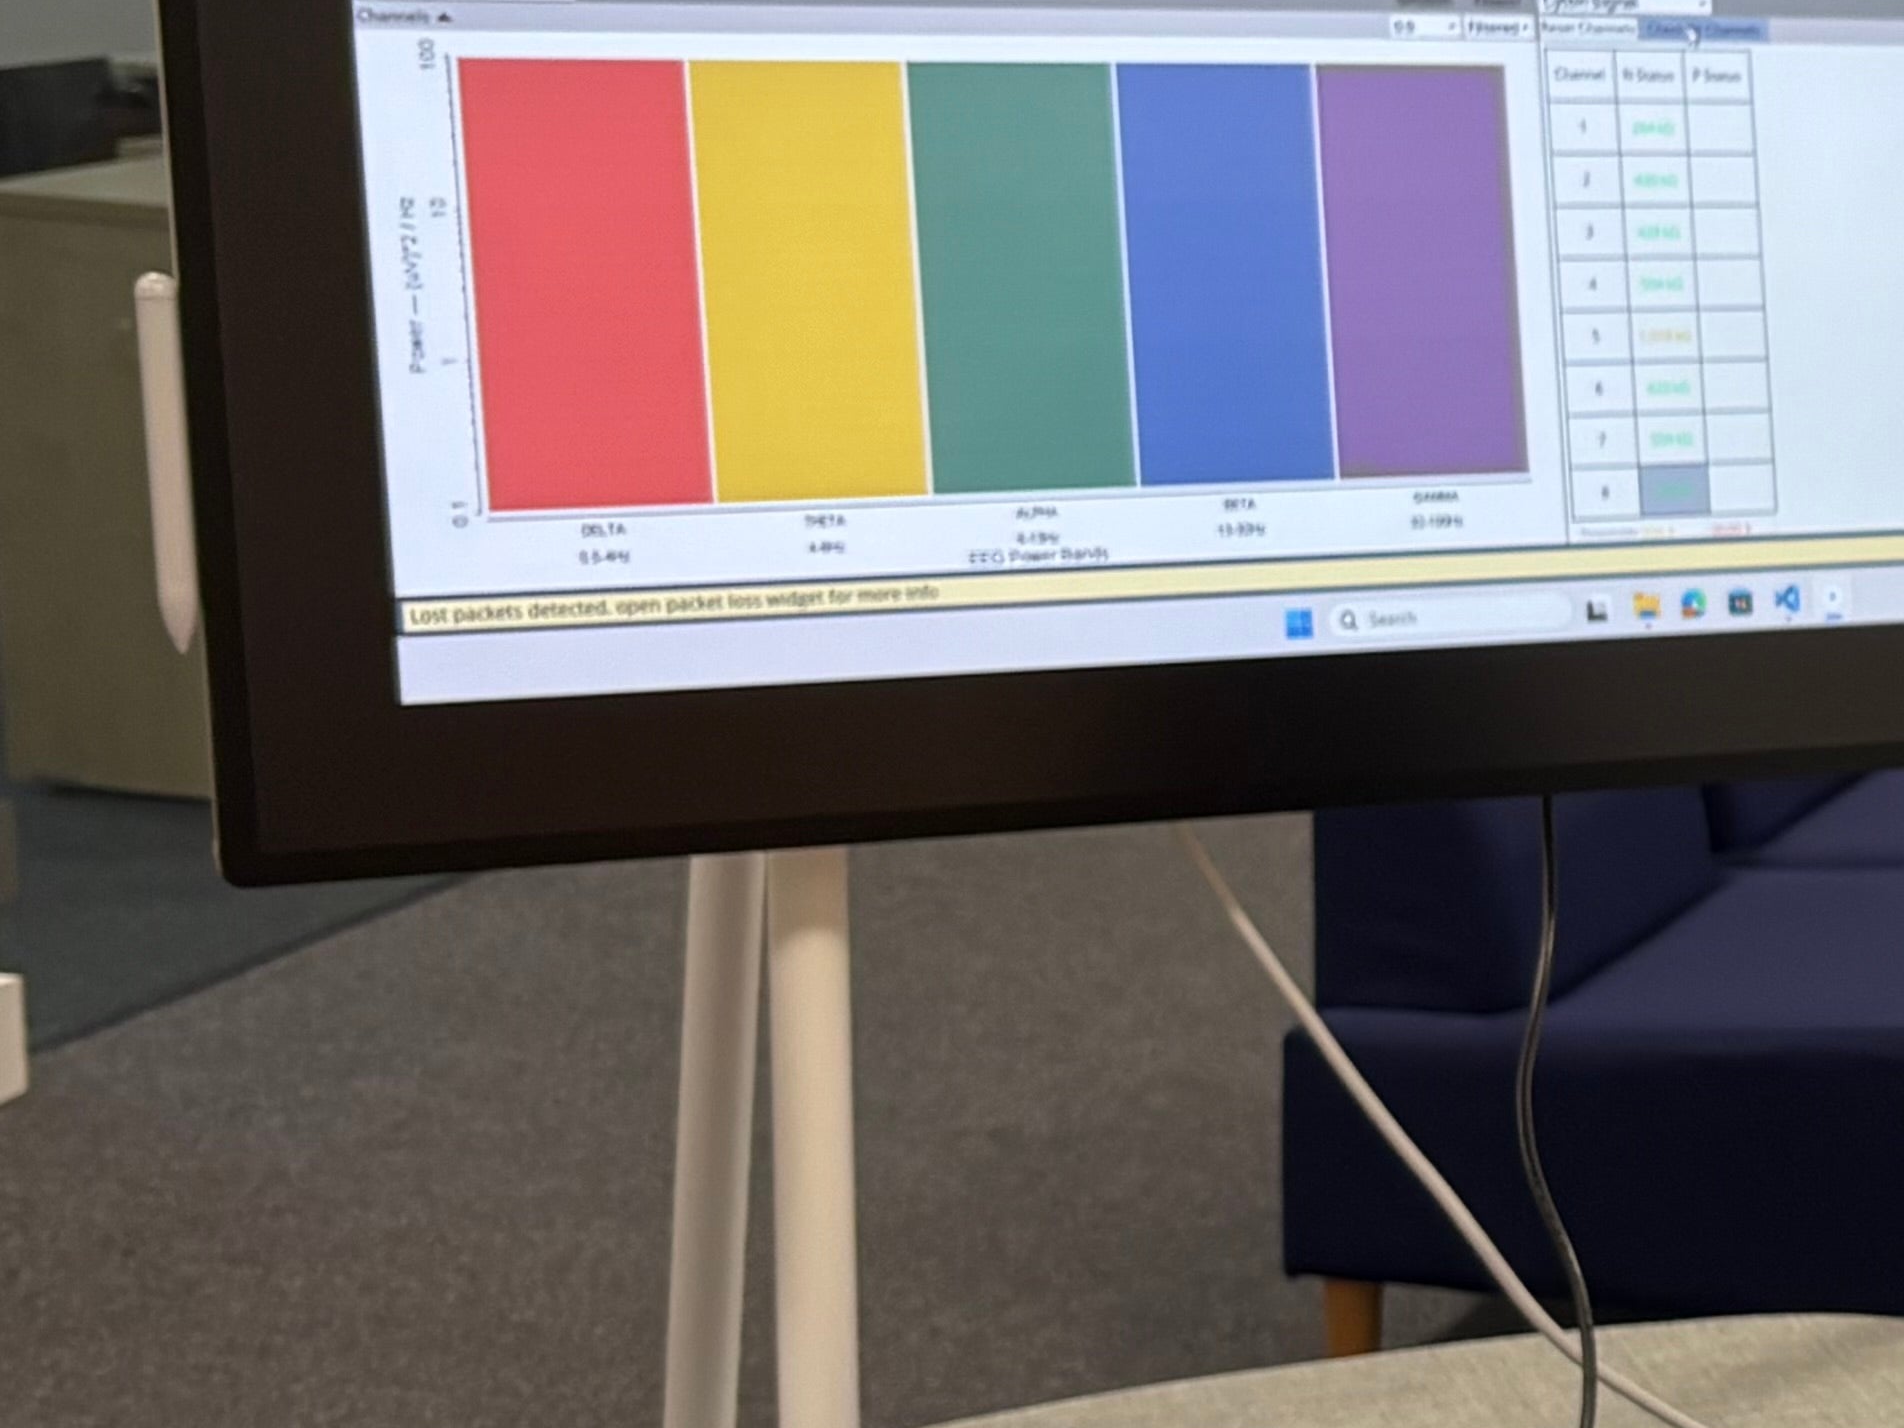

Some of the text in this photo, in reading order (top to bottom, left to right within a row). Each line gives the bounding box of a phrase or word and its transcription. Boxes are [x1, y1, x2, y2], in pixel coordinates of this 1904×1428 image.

[410, 608, 448, 626] Lost
[452, 602, 522, 625] packets
[614, 598, 660, 616] open
[665, 593, 723, 614] packet
[727, 592, 763, 610] loss
[827, 586, 852, 604] for
[855, 586, 901, 602] more
